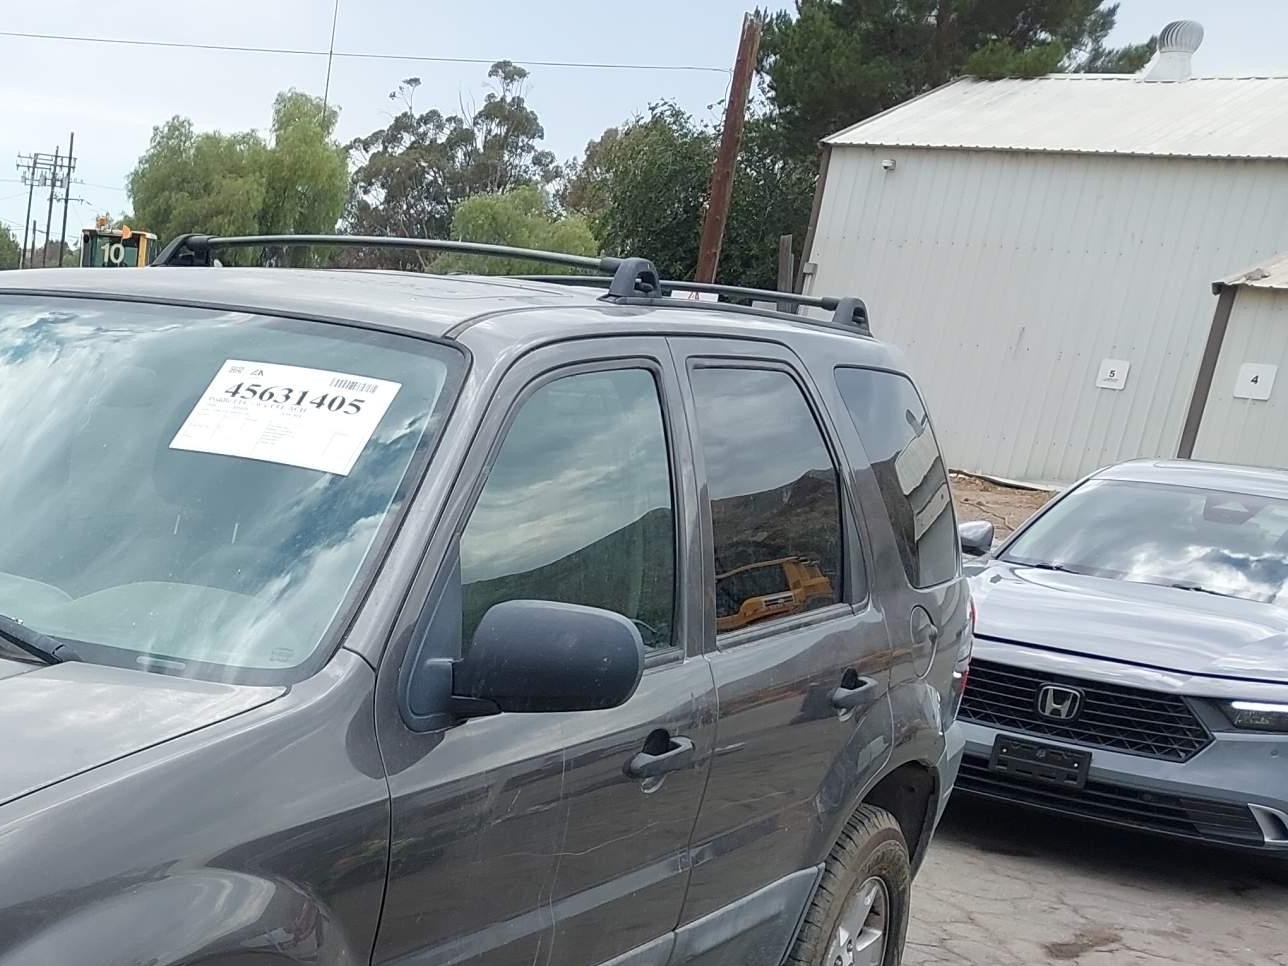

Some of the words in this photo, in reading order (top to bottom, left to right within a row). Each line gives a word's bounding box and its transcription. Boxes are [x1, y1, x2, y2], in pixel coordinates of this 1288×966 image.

[100, 242, 124, 264] 10
[1108, 369, 1116, 378] 5
[1250, 375, 1259, 385] 4
[224, 382, 366, 415] 45631405
